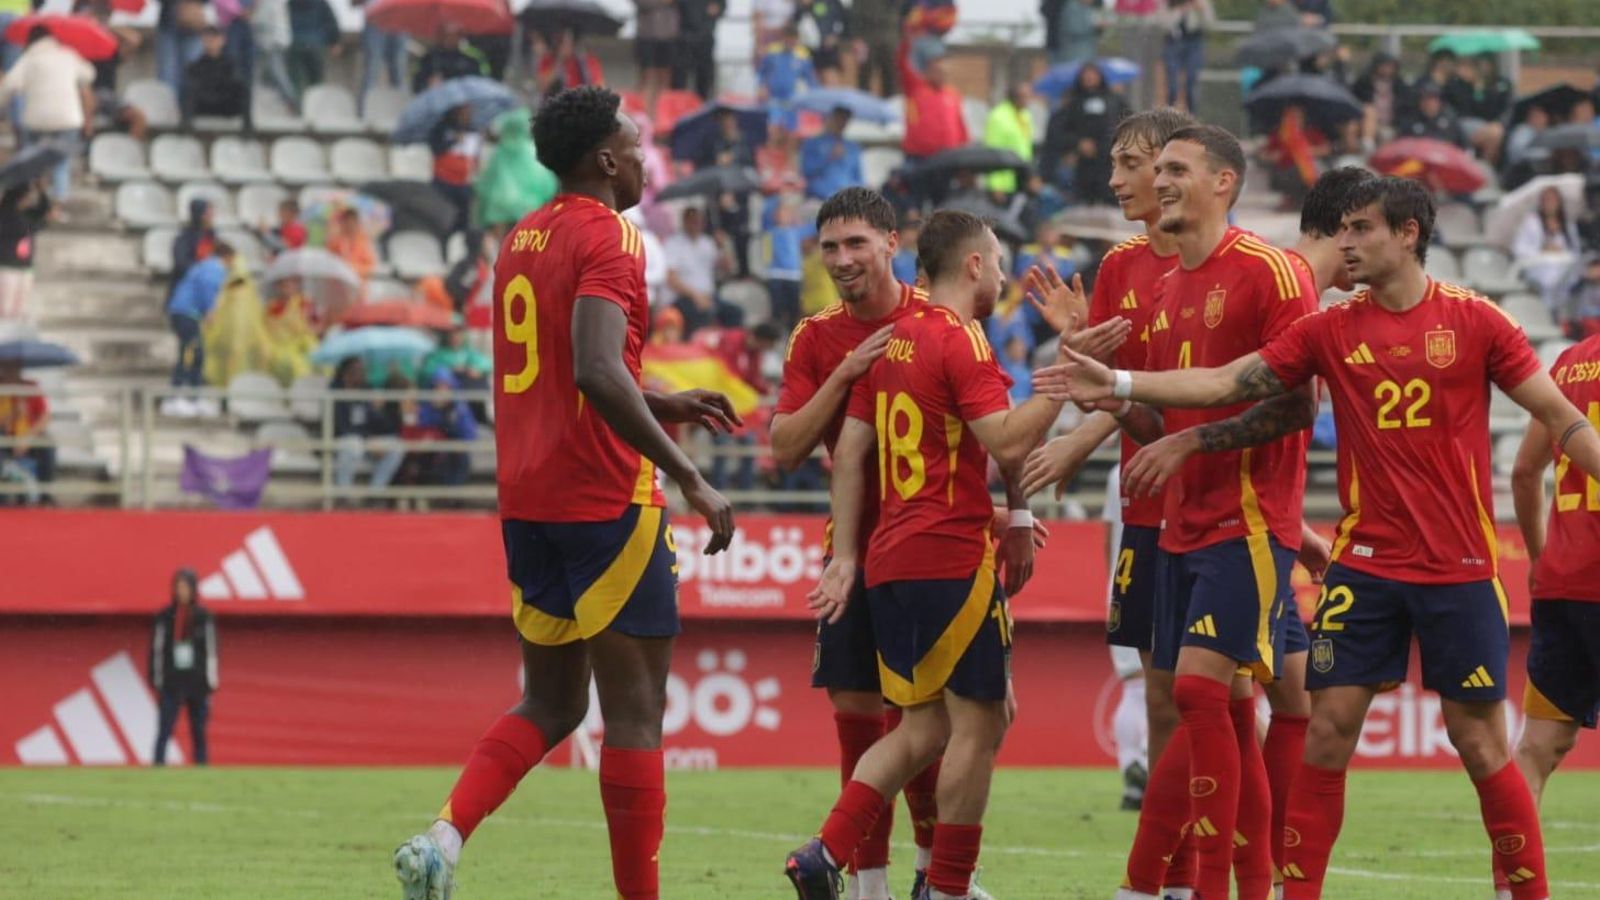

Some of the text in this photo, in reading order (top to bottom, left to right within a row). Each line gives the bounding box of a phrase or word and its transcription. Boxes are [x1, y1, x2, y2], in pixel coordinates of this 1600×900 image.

[511, 229, 551, 252] SAMU
[503, 273, 540, 394] 9
[1374, 378, 1432, 430] 22
[875, 391, 926, 501] 18
[1115, 548, 1134, 594] 4
